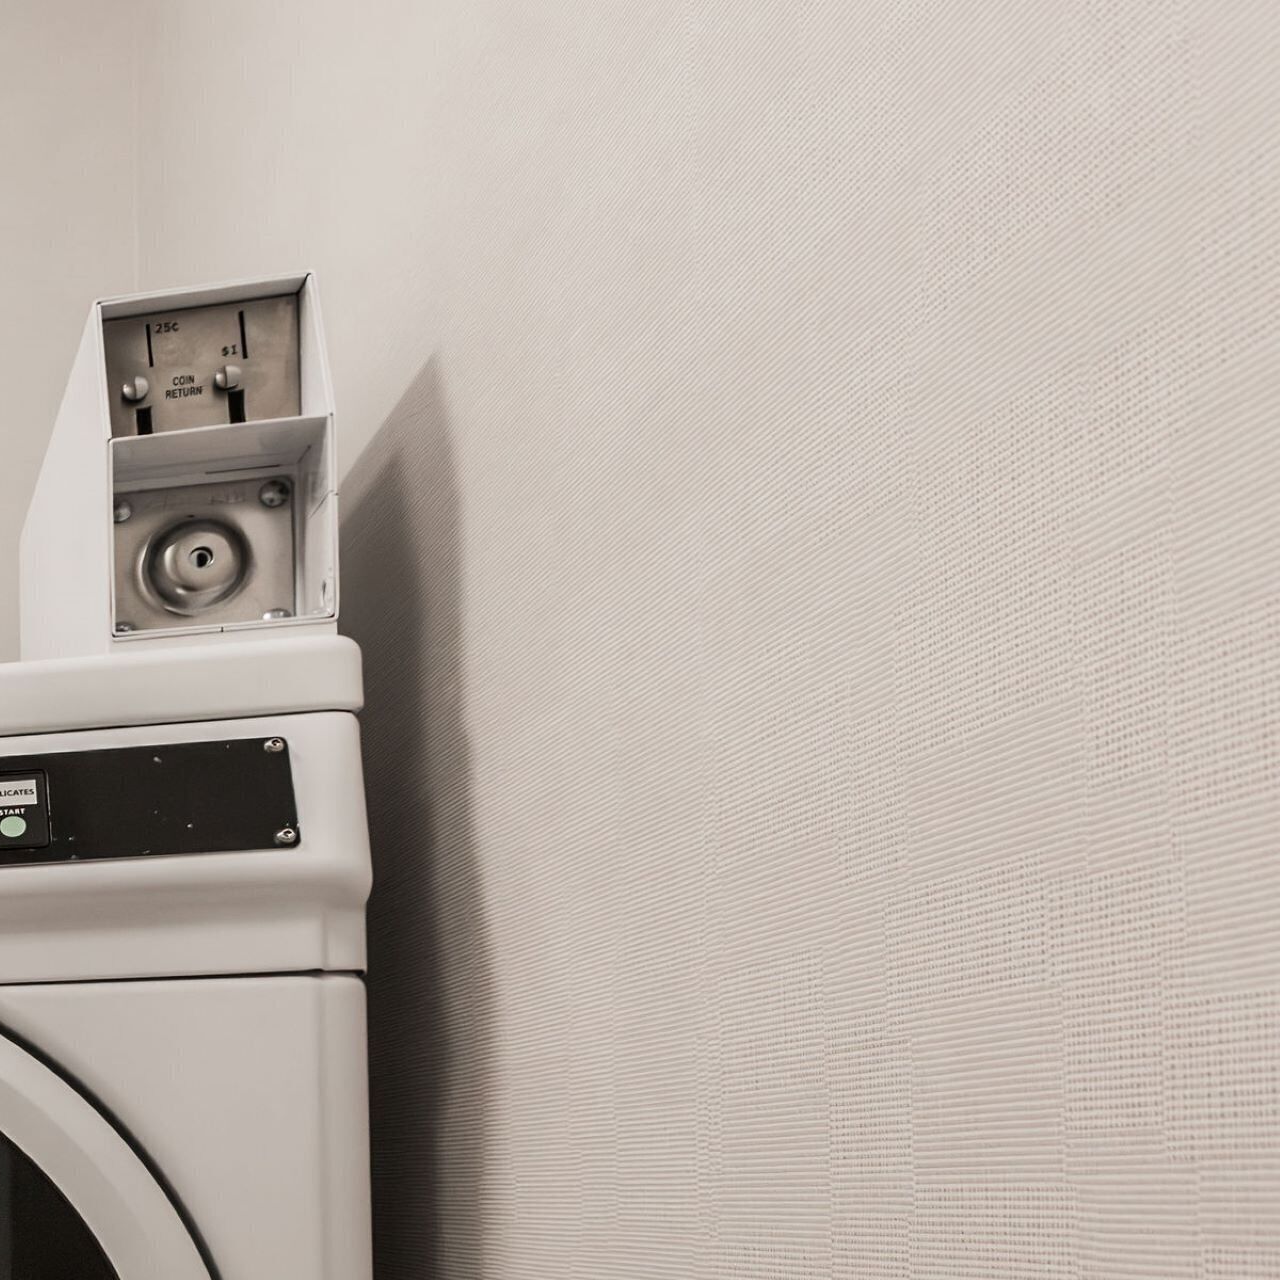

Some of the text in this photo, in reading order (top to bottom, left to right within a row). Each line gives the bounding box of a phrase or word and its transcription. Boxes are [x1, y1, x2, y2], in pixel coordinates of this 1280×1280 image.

[172, 375, 195, 386] COIN
[165, 385, 204, 399] RETURN
[0, 808, 25, 816] START
